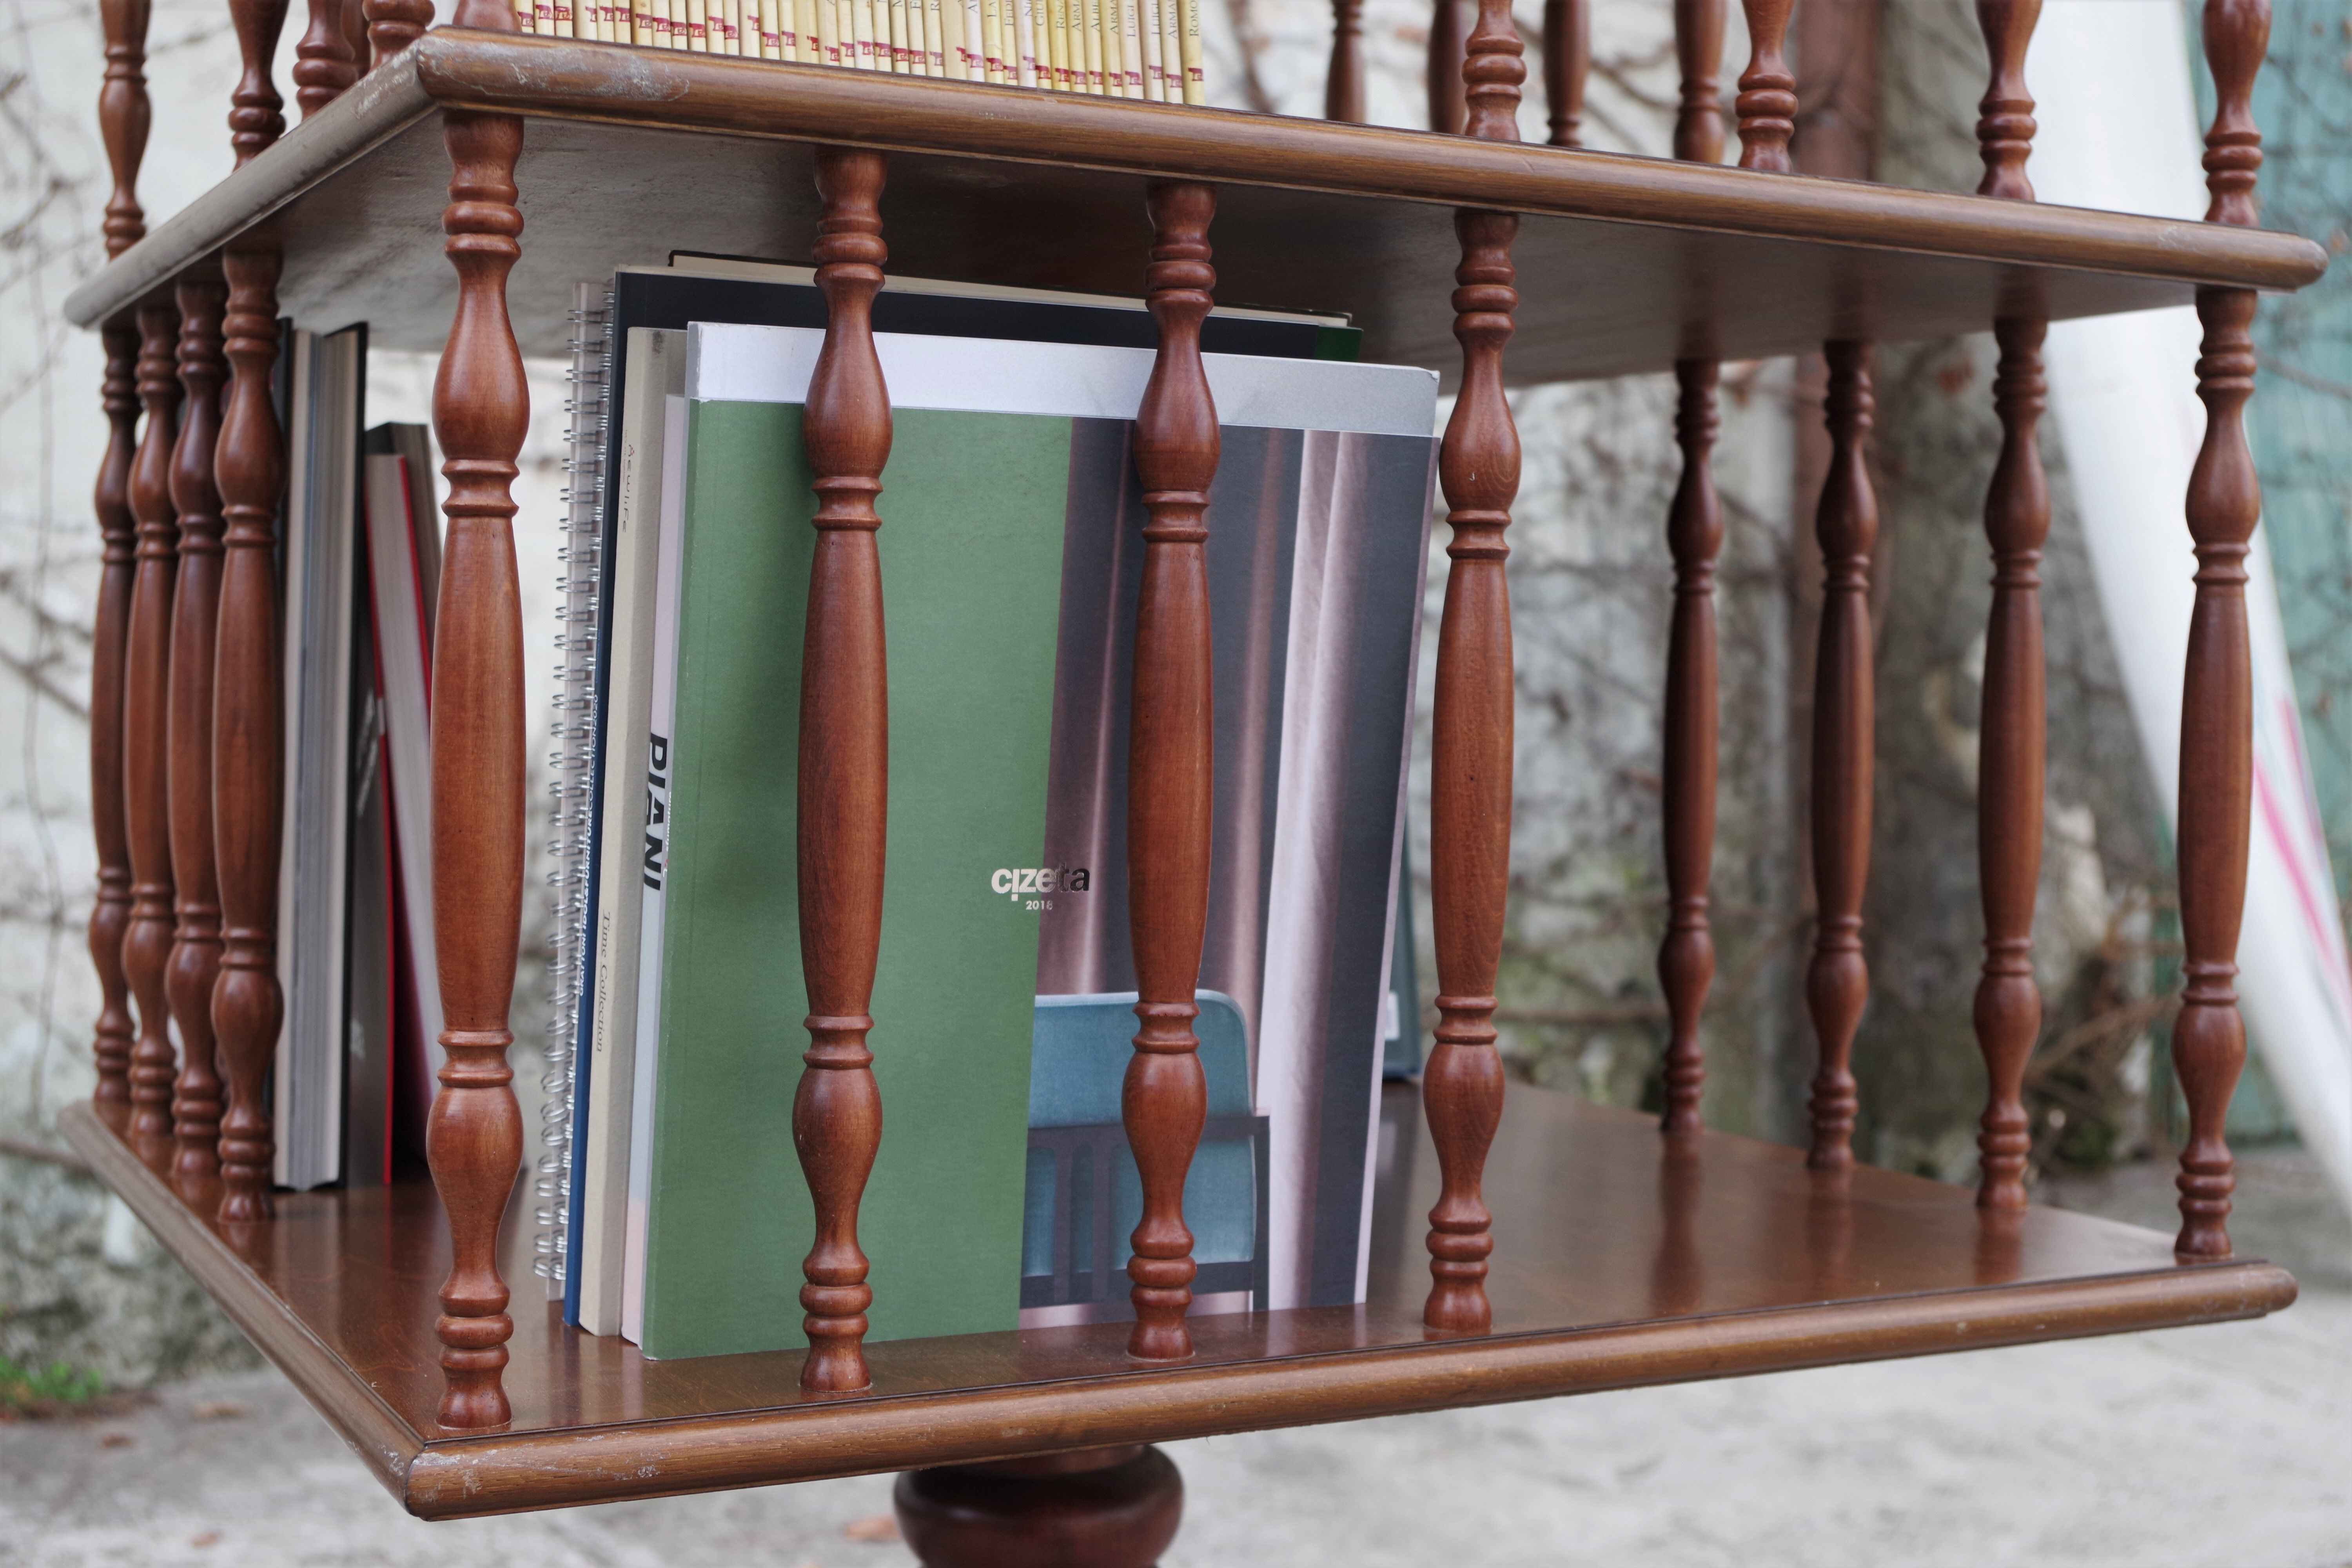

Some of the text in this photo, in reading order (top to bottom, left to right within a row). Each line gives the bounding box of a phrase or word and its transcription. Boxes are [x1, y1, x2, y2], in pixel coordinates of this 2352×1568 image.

[1005, 0, 1013, 26] FED
[1035, 0, 1044, 26] GIU
[1168, 0, 1177, 38] ARMA
[643, 733, 668, 891] PIANI
[991, 862, 1090, 901] cizeta
[596, 910, 610, 1053] Time Collection
